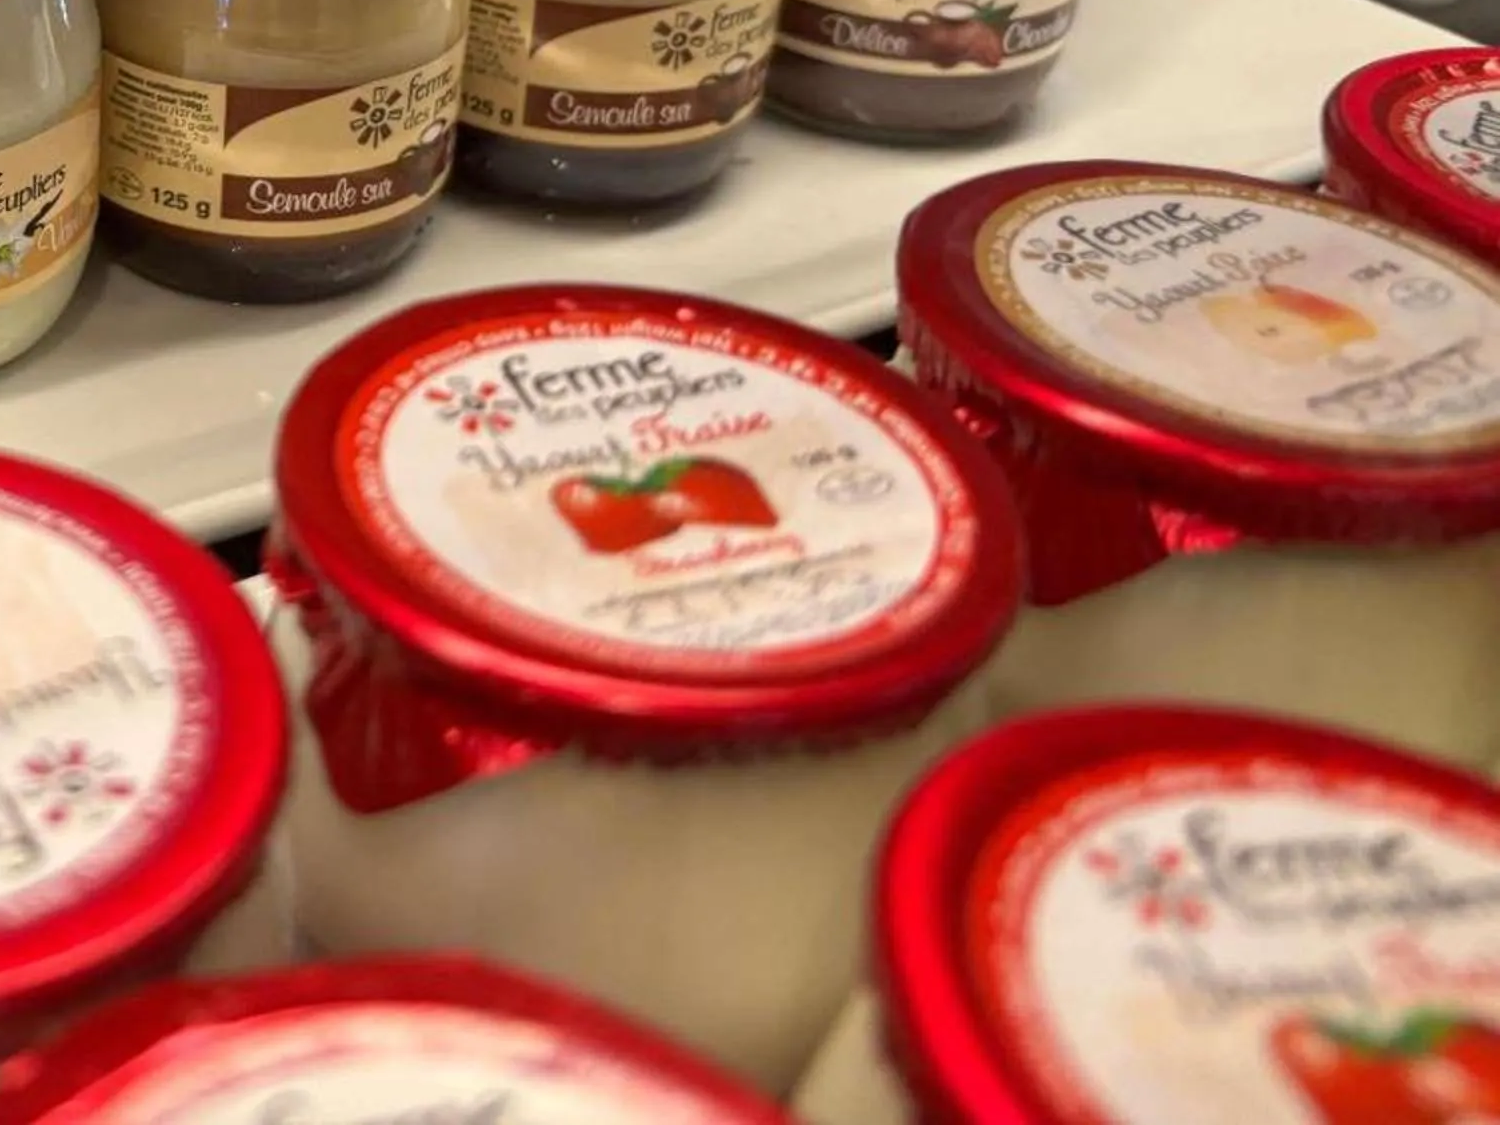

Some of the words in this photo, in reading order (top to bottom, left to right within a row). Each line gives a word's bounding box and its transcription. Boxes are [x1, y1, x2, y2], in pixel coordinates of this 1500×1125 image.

[546, 91, 655, 126] Semoule
[150, 186, 189, 211] 125
[194, 200, 211, 220] g
[246, 178, 357, 215] Semoule
[361, 177, 394, 205] sur
[1057, 201, 1197, 258] ferme
[1152, 207, 1263, 259] peupliers
[1091, 270, 1226, 325] Yaourt
[500, 350, 671, 411] ferme
[592, 367, 746, 420] peupliers
[458, 435, 632, 492] Yaourt
[631, 409, 773, 456] Fraise
